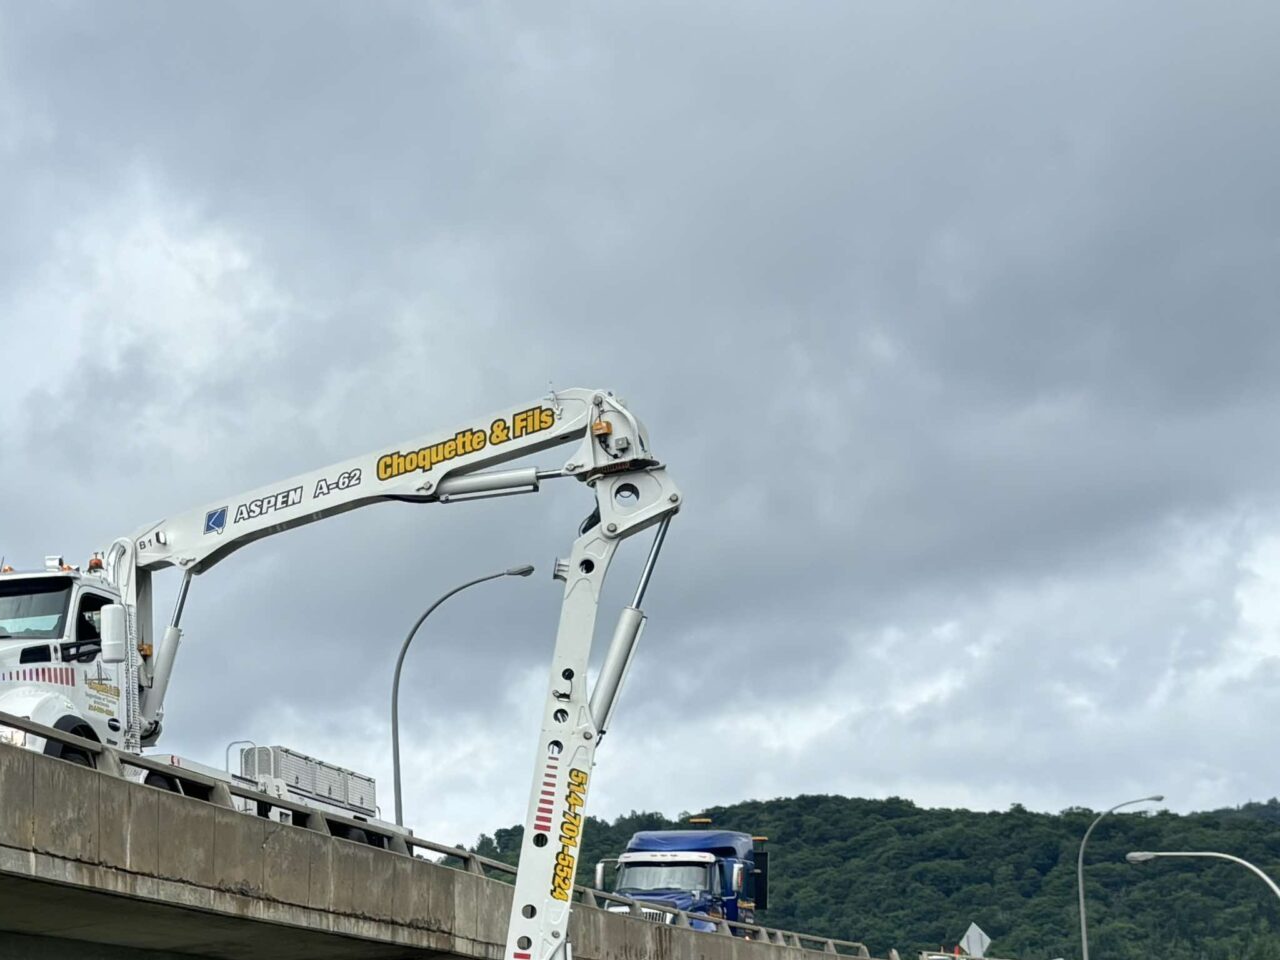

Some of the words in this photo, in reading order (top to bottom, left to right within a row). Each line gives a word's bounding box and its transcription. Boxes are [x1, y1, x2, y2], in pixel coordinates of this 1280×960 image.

[376, 427, 487, 482] Choquette
[489, 418, 510, 445] &
[512, 405, 555, 439] Fils
[234, 486, 303, 524] ASPEN
[313, 469, 362, 498] A-62
[550, 767, 589, 903] 514-701-5524
